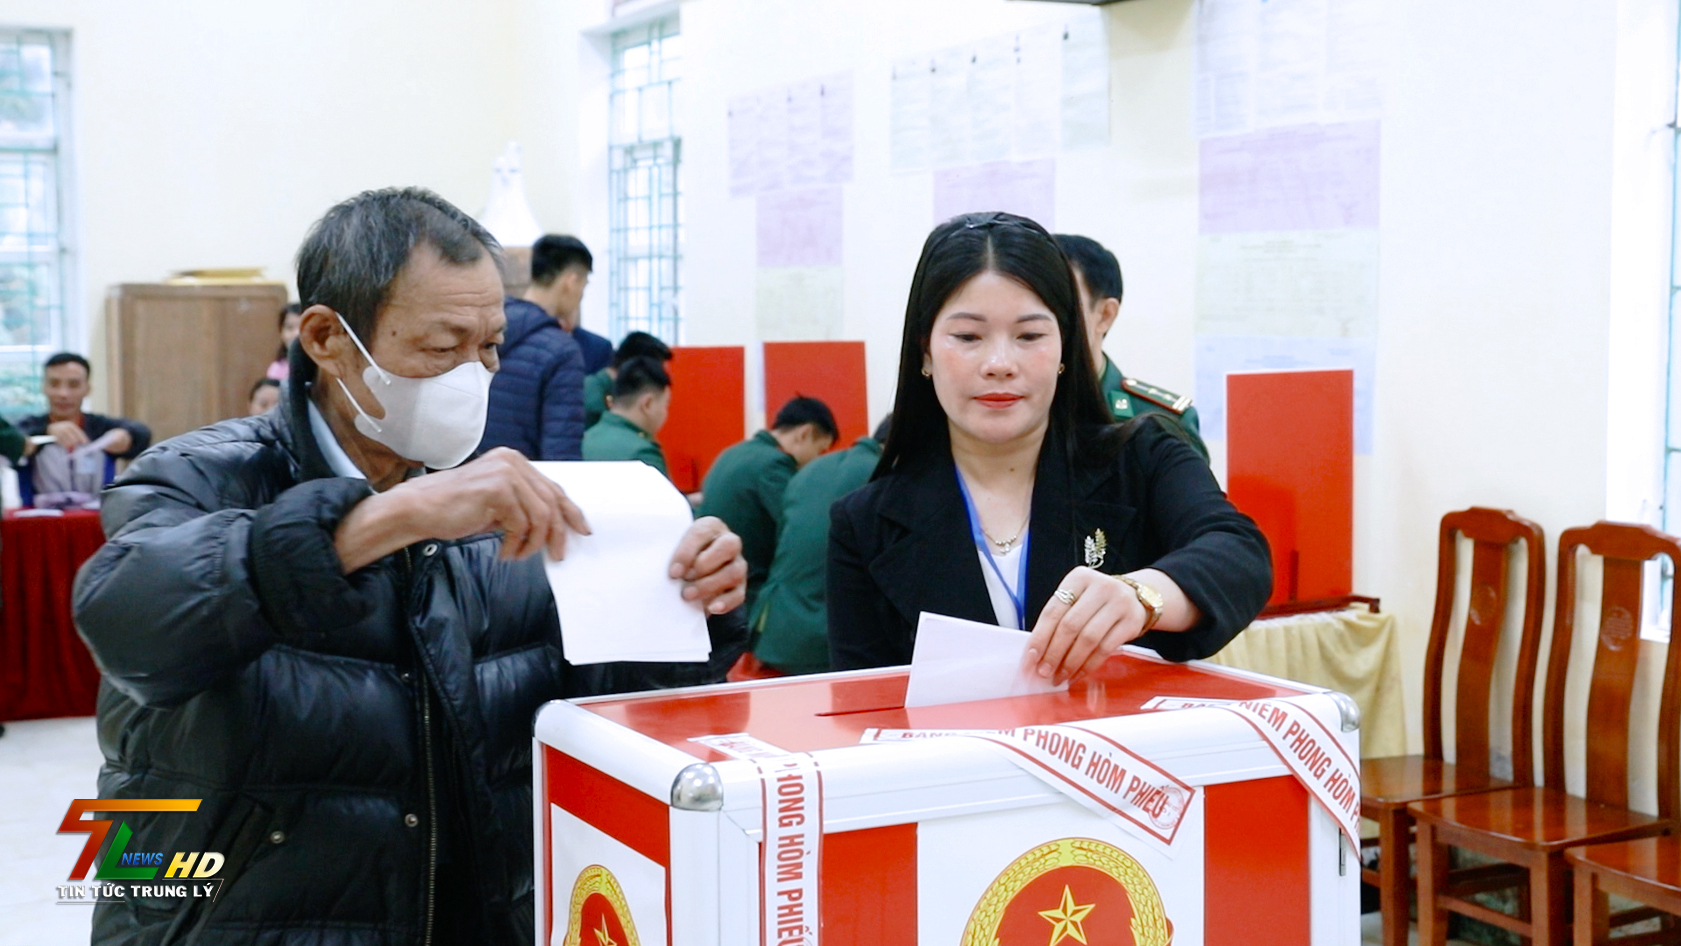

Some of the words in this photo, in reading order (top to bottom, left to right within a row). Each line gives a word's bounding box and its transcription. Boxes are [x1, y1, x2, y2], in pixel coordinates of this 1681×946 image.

[1023, 728, 1086, 770] PHONG
[1084, 752, 1127, 794] HÒM
[1122, 774, 1169, 818] PHIẾU
[1282, 720, 1332, 780] PHONG
[1323, 768, 1356, 813] HÒM
[777, 834, 811, 882] HÒM
